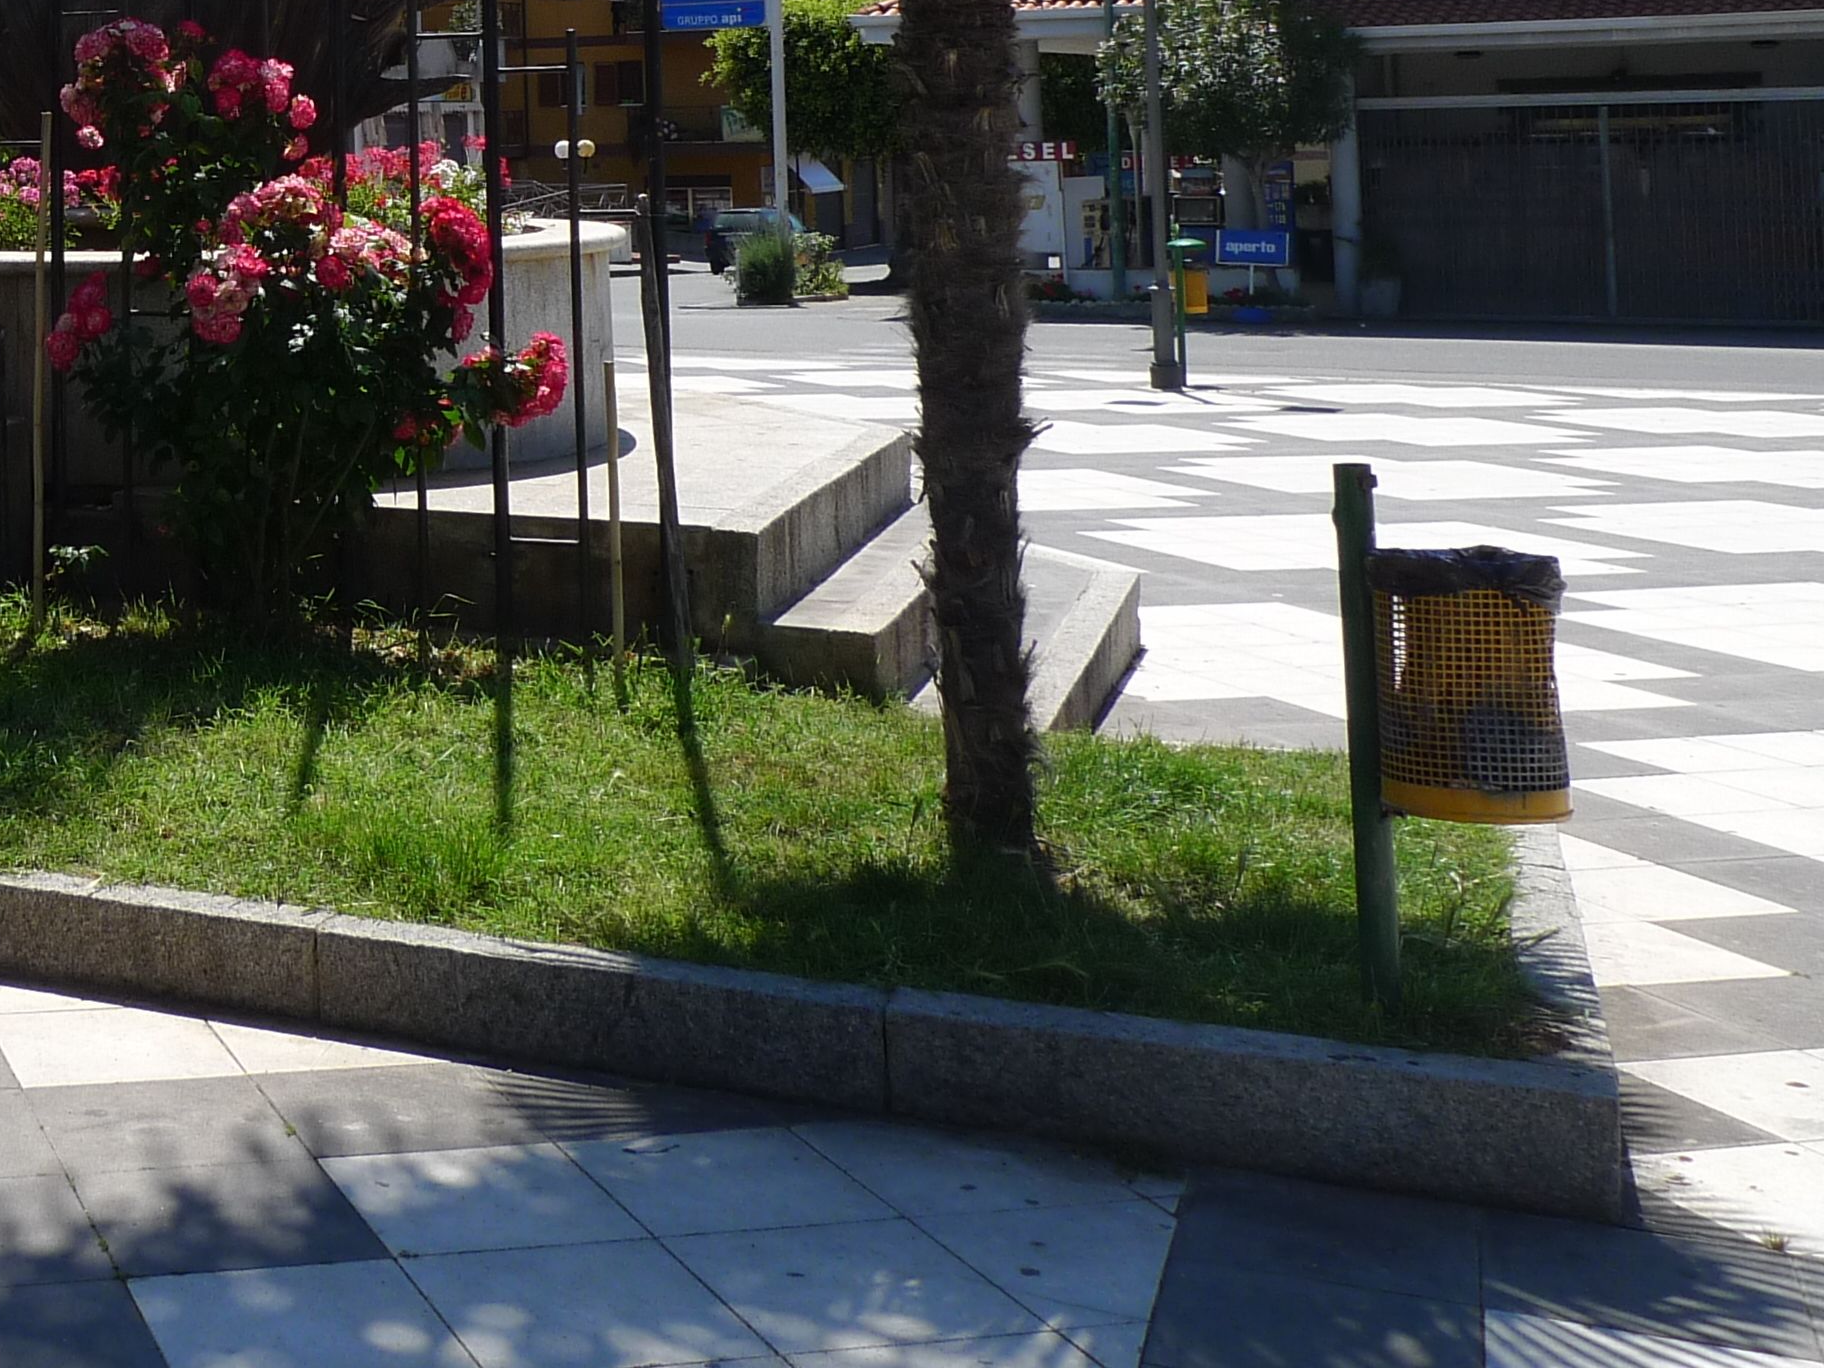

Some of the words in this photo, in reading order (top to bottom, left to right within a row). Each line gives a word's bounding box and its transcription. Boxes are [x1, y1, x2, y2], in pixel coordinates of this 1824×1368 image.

[677, 15, 718, 26] GRUPPO
[721, 8, 742, 25] api
[1225, 241, 1276, 255] aperto
